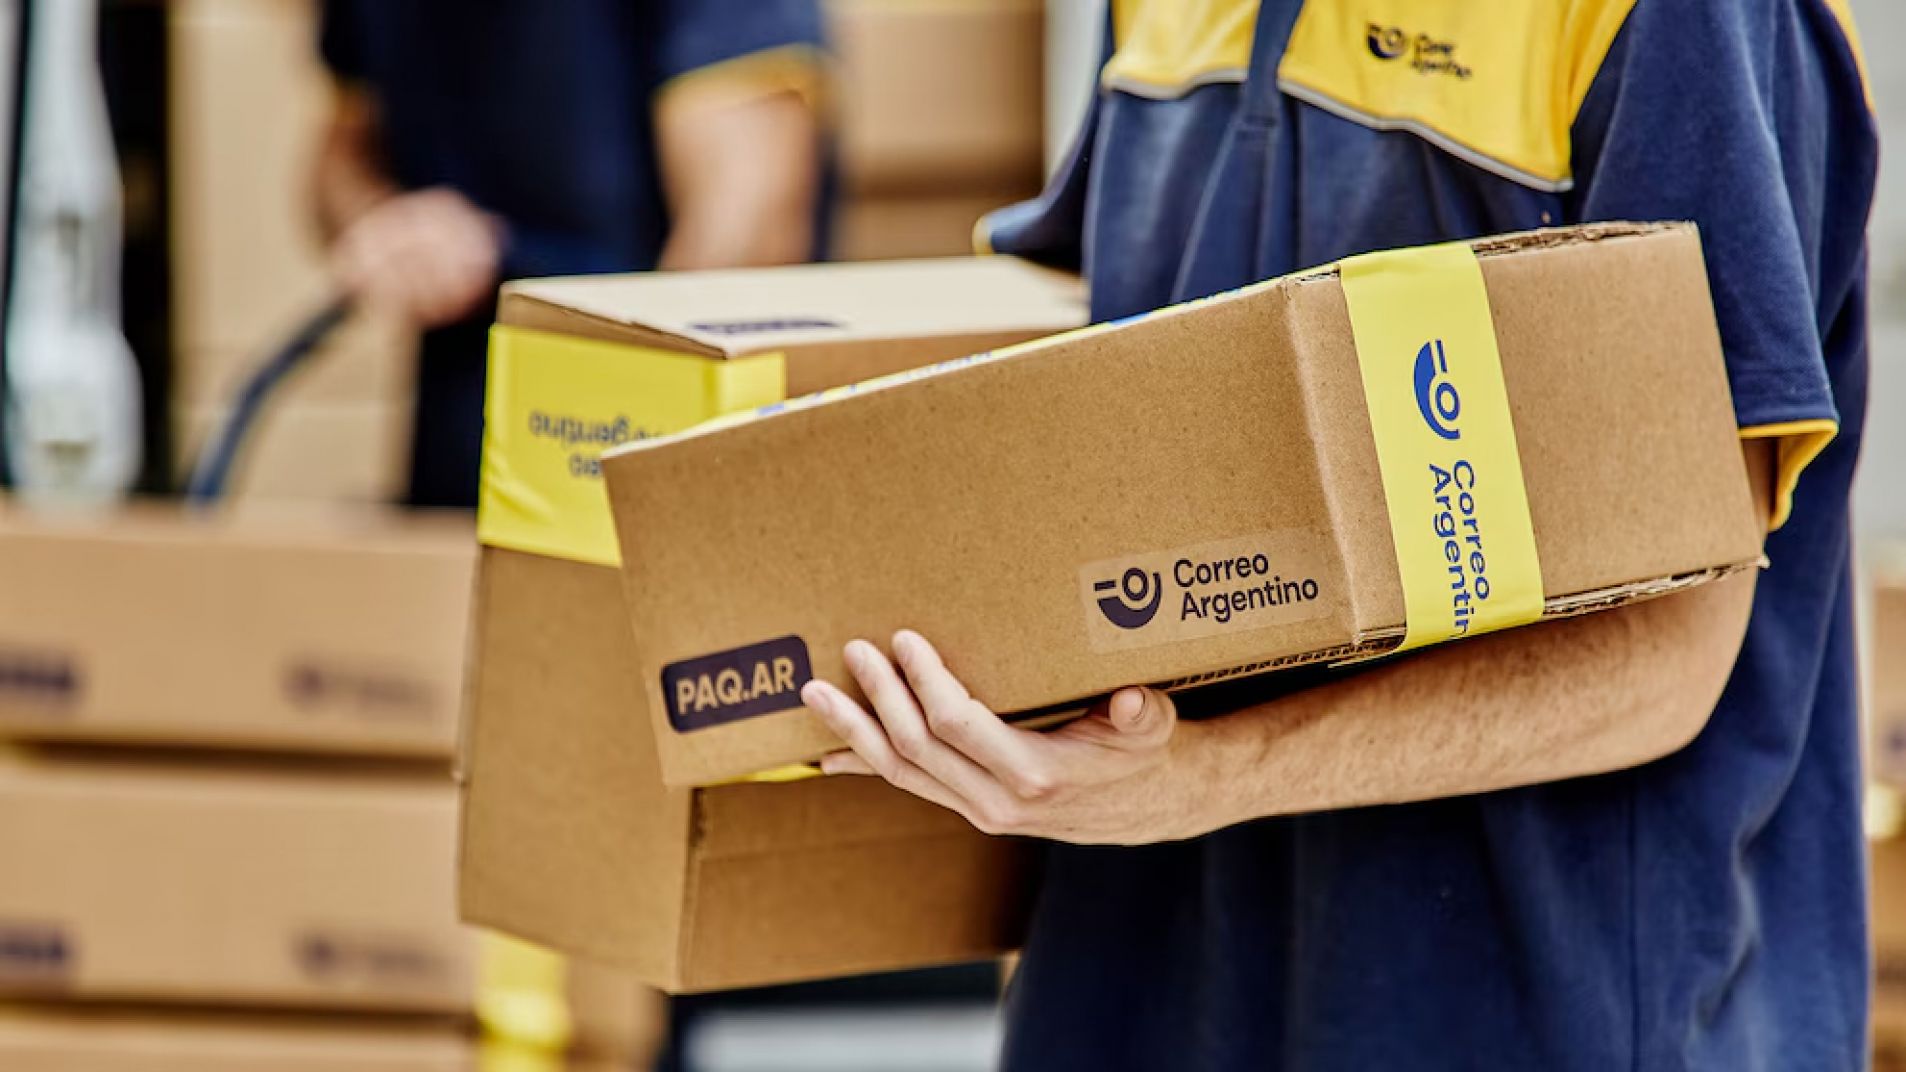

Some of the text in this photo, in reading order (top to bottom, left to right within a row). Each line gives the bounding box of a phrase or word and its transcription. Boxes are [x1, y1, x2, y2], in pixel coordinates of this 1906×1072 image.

[1429, 463, 1474, 636] Argentin
[1453, 459, 1490, 600] Correo
[1173, 553, 1269, 588] Correo
[1180, 575, 1319, 624] Argentino
[675, 656, 796, 715] PAQ.AR
